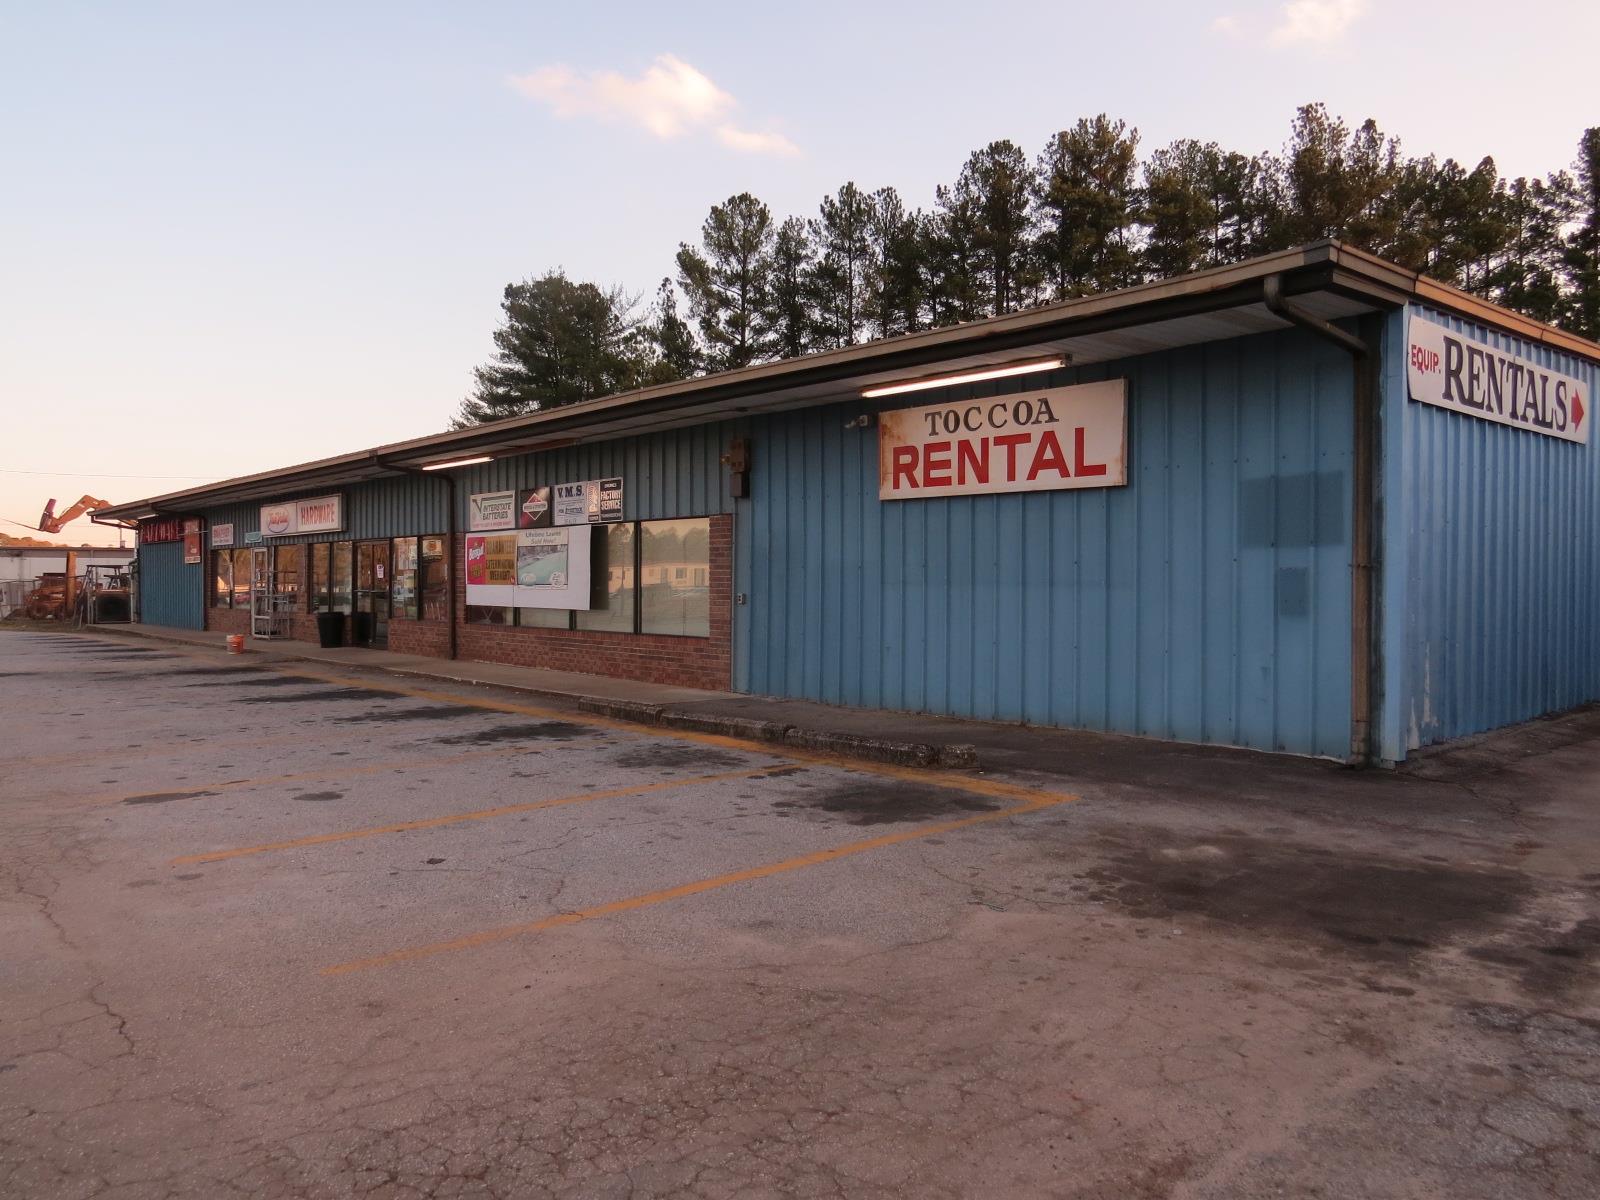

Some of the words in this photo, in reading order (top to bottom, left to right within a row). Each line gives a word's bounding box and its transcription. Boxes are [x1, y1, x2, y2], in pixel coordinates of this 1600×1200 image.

[1411, 344, 1441, 375] EQUIP.
[1442, 335, 1567, 432] RENTALS
[925, 397, 1059, 436] TOCCOA
[893, 427, 1106, 489] RENTAL
[301, 503, 335, 525] HARDWARE
[482, 511, 508, 520] BATTERIES
[483, 502, 512, 512] INTERSTATE
